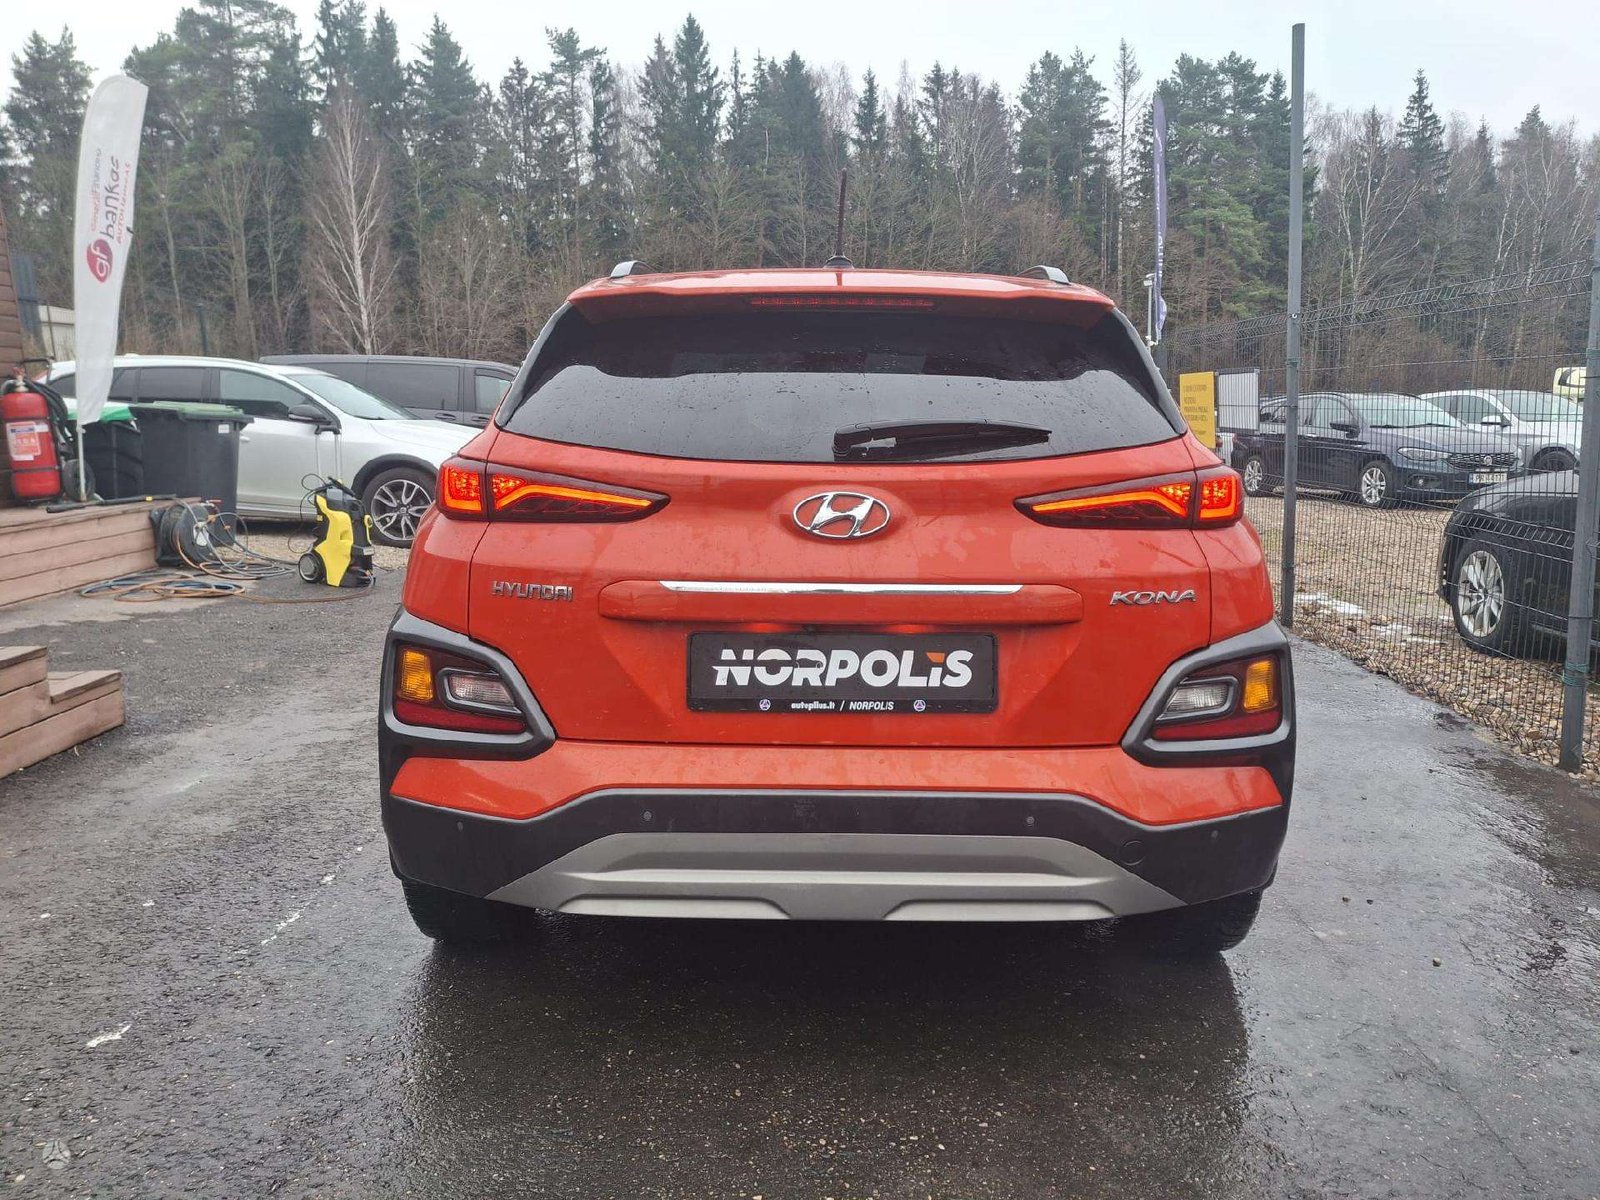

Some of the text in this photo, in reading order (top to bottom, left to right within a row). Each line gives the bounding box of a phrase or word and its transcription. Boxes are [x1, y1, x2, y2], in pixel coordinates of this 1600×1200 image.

[99, 155, 119, 240] bankas
[491, 580, 574, 602] HYUNDAI
[1109, 589, 1197, 606] KONA
[791, 701, 835, 711] autoplius.lt
[849, 701, 895, 711] NORPOLIS
